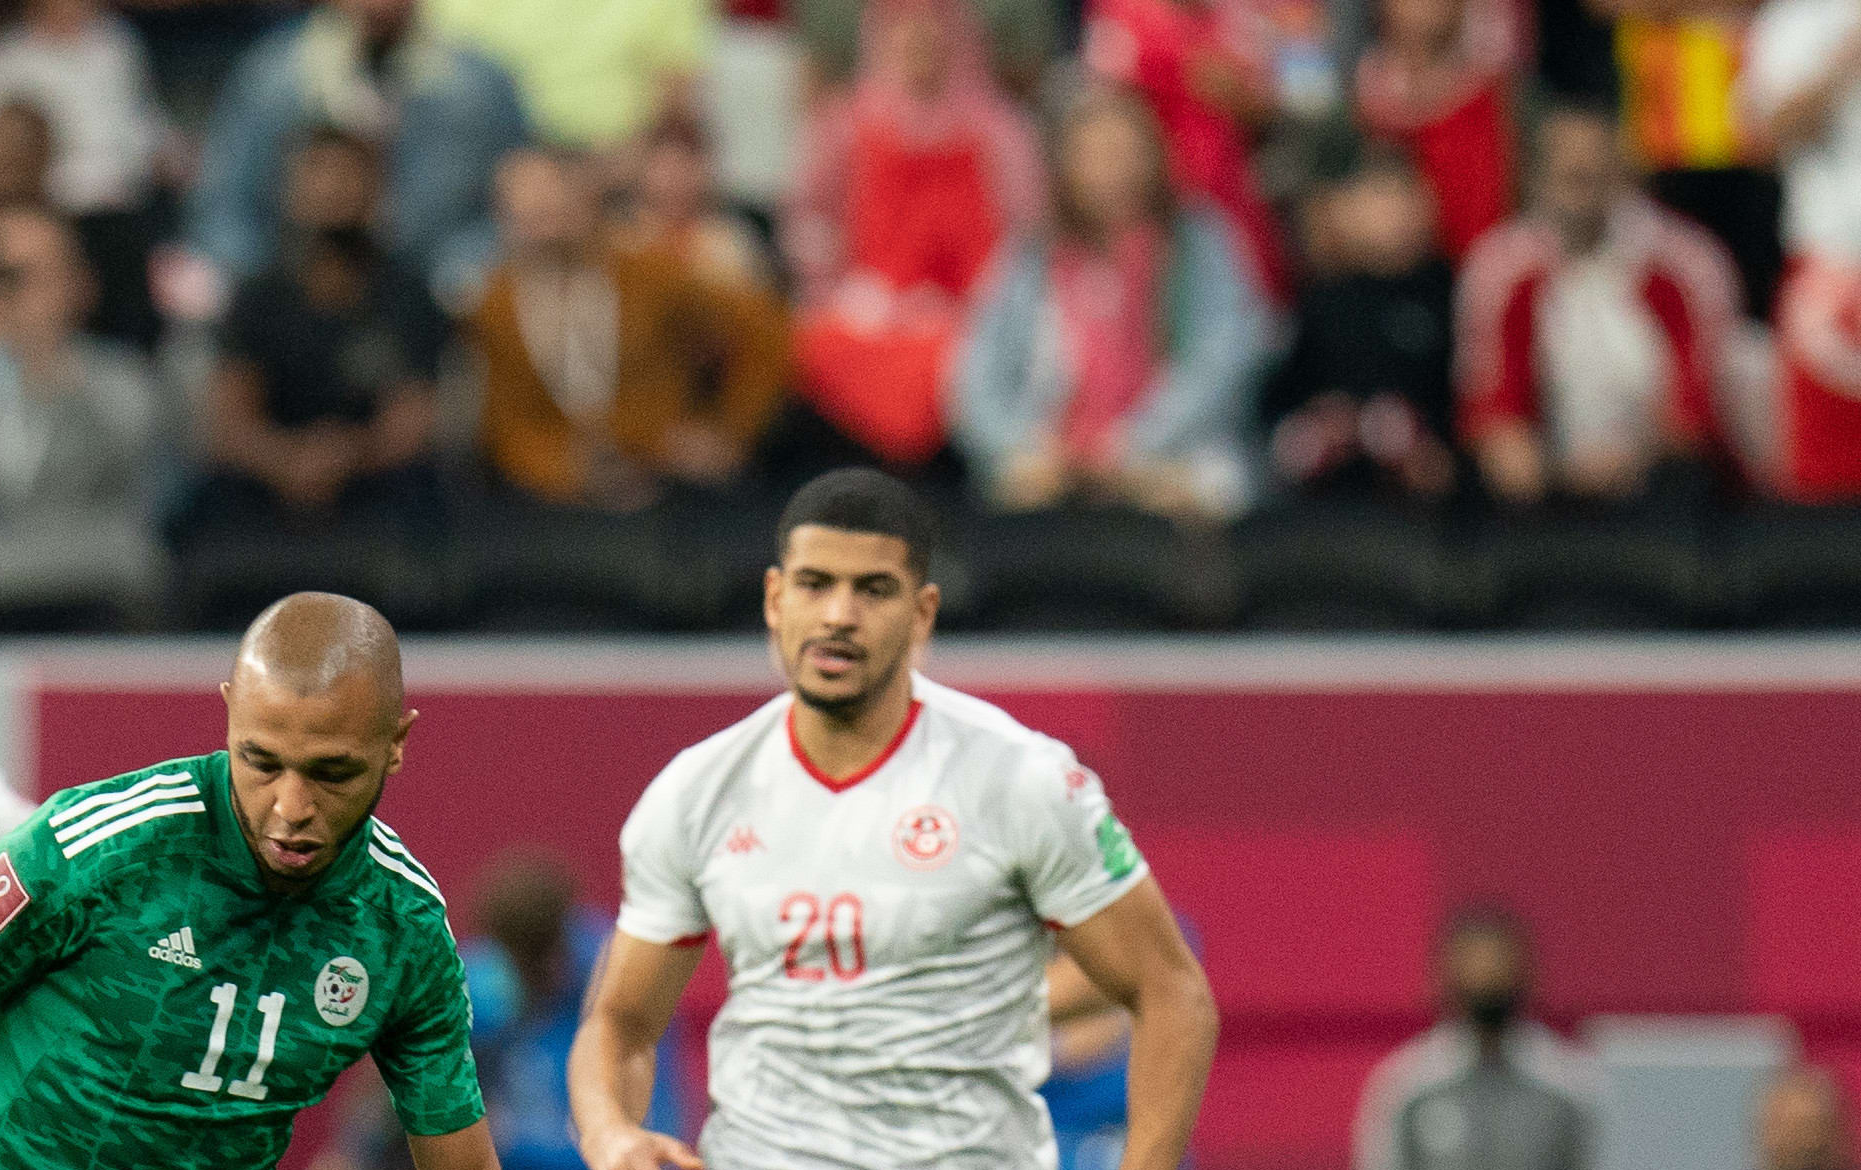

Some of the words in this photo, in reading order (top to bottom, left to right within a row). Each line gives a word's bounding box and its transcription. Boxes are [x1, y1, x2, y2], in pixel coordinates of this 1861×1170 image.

[148, 946, 203, 970] adidas
[778, 891, 866, 983] 20
[180, 982, 286, 1100] 11
